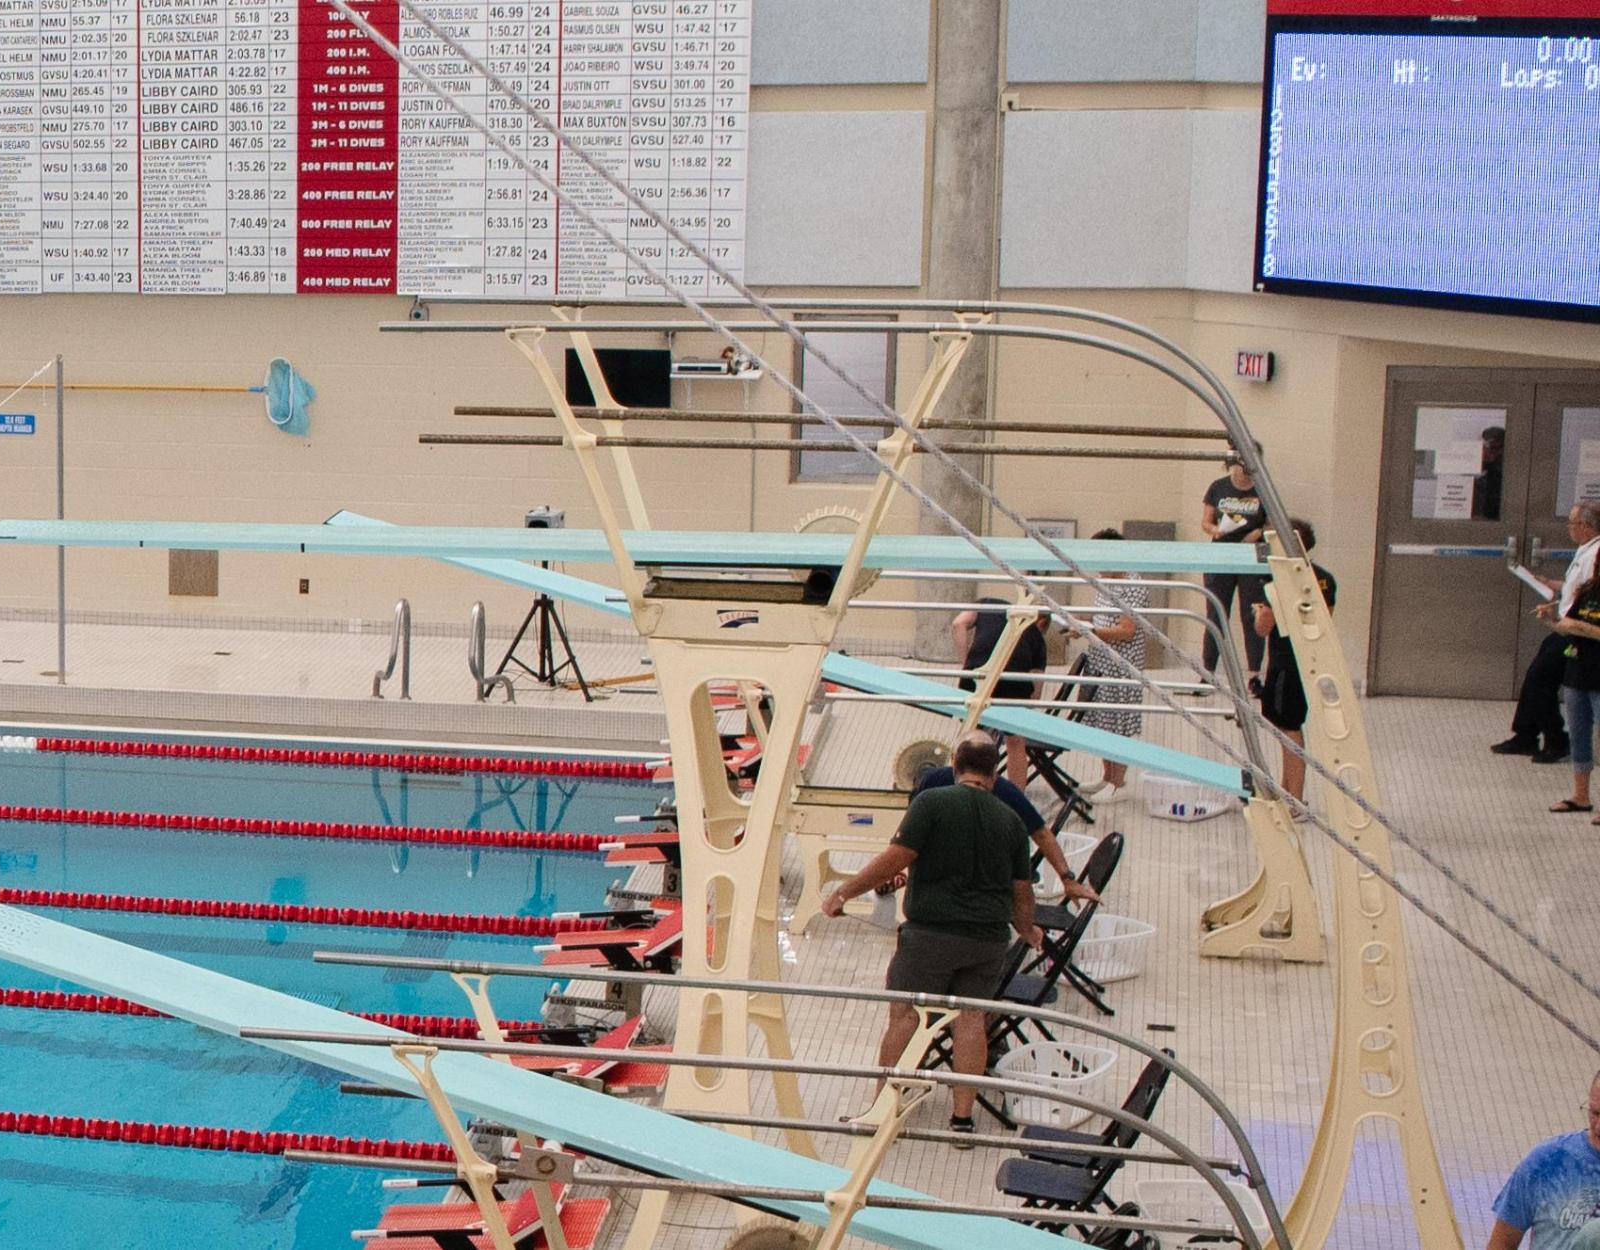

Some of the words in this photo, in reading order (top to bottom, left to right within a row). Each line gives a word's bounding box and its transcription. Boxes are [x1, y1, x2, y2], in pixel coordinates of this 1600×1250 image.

[490, 7, 523, 18] 46.99
[531, 6, 550, 17] '24
[633, 4, 666, 14] GVSU
[676, 4, 708, 14] 46.27
[72, 16, 100, 26] 55.37
[146, 15, 173, 25] FLORA
[235, 12, 260, 23] 56.18
[328, 12, 345, 21] 100
[9, 18, 34, 28] HELM
[41, 18, 67, 27] NMU
[634, 23, 663, 33] WSU
[230, 30, 262, 41] 2:02.47
[327, 29, 346, 38] 200
[404, 27, 432, 39] ALMOS
[489, 26, 525, 36] 1:50.27
[531, 25, 550, 36] '24
[41, 36, 67, 45] NMU
[147, 32, 174, 43] FLORA
[404, 46, 440, 57] LOGAN
[490, 44, 526, 55] 1:47.14
[531, 43, 550, 54] '24
[633, 42, 665, 52] GVSU
[1537, 36, 1592, 62] 0.00
[9, 53, 33, 62] HELM
[41, 53, 67, 62] NMU
[72, 51, 108, 61] 2:01.17
[141, 51, 172, 62] LYDIA
[174, 50, 218, 61] MATTAR
[228, 48, 265, 60] 2:03.78
[327, 48, 346, 58] 200
[349, 48, 370, 58] I.M.
[326, 66, 346, 75] 400
[349, 66, 370, 75] I.M.
[490, 62, 526, 73] 3:57.49
[531, 61, 550, 73] '24
[634, 60, 663, 71] WSU
[1291, 57, 1326, 81] Ev:
[42, 71, 69, 80] GVSU
[72, 69, 108, 79] 4:20.41
[141, 68, 172, 79] LYDIA
[175, 67, 218, 78] MATTAR
[228, 66, 266, 77] 4:22.82
[313, 84, 328, 93] 1M
[349, 83, 384, 93] DIVES
[402, 82, 424, 92] RORY
[563, 81, 591, 91] JUSTIN
[633, 79, 666, 90] SVSU
[674, 79, 705, 89] 301.00
[41, 88, 67, 97] NMU
[142, 87, 177, 98] LIBBY
[180, 86, 218, 97] CAIRD
[228, 84, 263, 96] 305.93
[228, 102, 263, 114] 486.16
[312, 102, 328, 111] 1M
[349, 101, 384, 111] DIVES
[402, 100, 433, 111] JUSTIN
[632, 98, 665, 108] GVSU
[42, 106, 69, 115] GVSU
[72, 104, 104, 114] 449.10
[142, 104, 177, 115] LIBBY
[180, 103, 218, 114] CAIRD
[228, 120, 263, 132] 303.10
[311, 120, 328, 129] 3M
[349, 119, 384, 129] DIVES
[402, 118, 426, 129] RORY
[489, 118, 523, 129] 318.30
[563, 116, 585, 128] MAX
[587, 116, 626, 128] BUXTON
[632, 117, 666, 127] SVSU
[673, 115, 707, 127] 307.73
[42, 123, 67, 132] NMU
[142, 122, 177, 133] LIBBY
[180, 121, 218, 132] CAIRD
[42, 140, 69, 150] GVSU
[142, 139, 177, 150] LIBBY
[180, 138, 218, 149] CAIRD
[228, 138, 263, 150] 467.05
[311, 139, 328, 148] 3M
[349, 138, 384, 148] DIVES
[400, 137, 424, 147] RORY
[425, 136, 469, 147] KAUFFMAN
[631, 135, 664, 146] GVSU
[43, 163, 68, 173] WSU
[229, 161, 266, 172] 1:35.26
[302, 162, 320, 171] 200
[324, 162, 354, 171] FREE
[356, 162, 395, 171] RELAY
[634, 158, 661, 168] WSU
[43, 191, 68, 201] WSU
[229, 189, 266, 200] 3:28.86
[302, 191, 321, 200] 400
[325, 191, 354, 200] FREE
[357, 191, 395, 200] RELAY
[487, 189, 522, 200] 2:56.81
[42, 220, 64, 230] NMU
[230, 218, 268, 229] 7:40.49
[302, 219, 320, 229] 800
[323, 219, 352, 229] FREE
[355, 219, 392, 229] RELAY
[487, 217, 523, 228] 6:33.15
[44, 248, 69, 258] WSU
[229, 246, 266, 257] 1:43.33
[303, 248, 322, 257] 200
[325, 248, 350, 257] MED
[353, 247, 391, 257] RELAY
[487, 246, 522, 257] 1:27.82
[50, 272, 65, 282] UF
[229, 271, 266, 282] 3:46.89
[303, 277, 322, 287] 400
[325, 277, 350, 287] MED
[353, 277, 391, 287] RELAY
[487, 274, 522, 285] 3:15.97
[1237, 351, 1264, 378] EXIT
[668, 873, 678, 893] 3
[611, 981, 622, 999] 4
